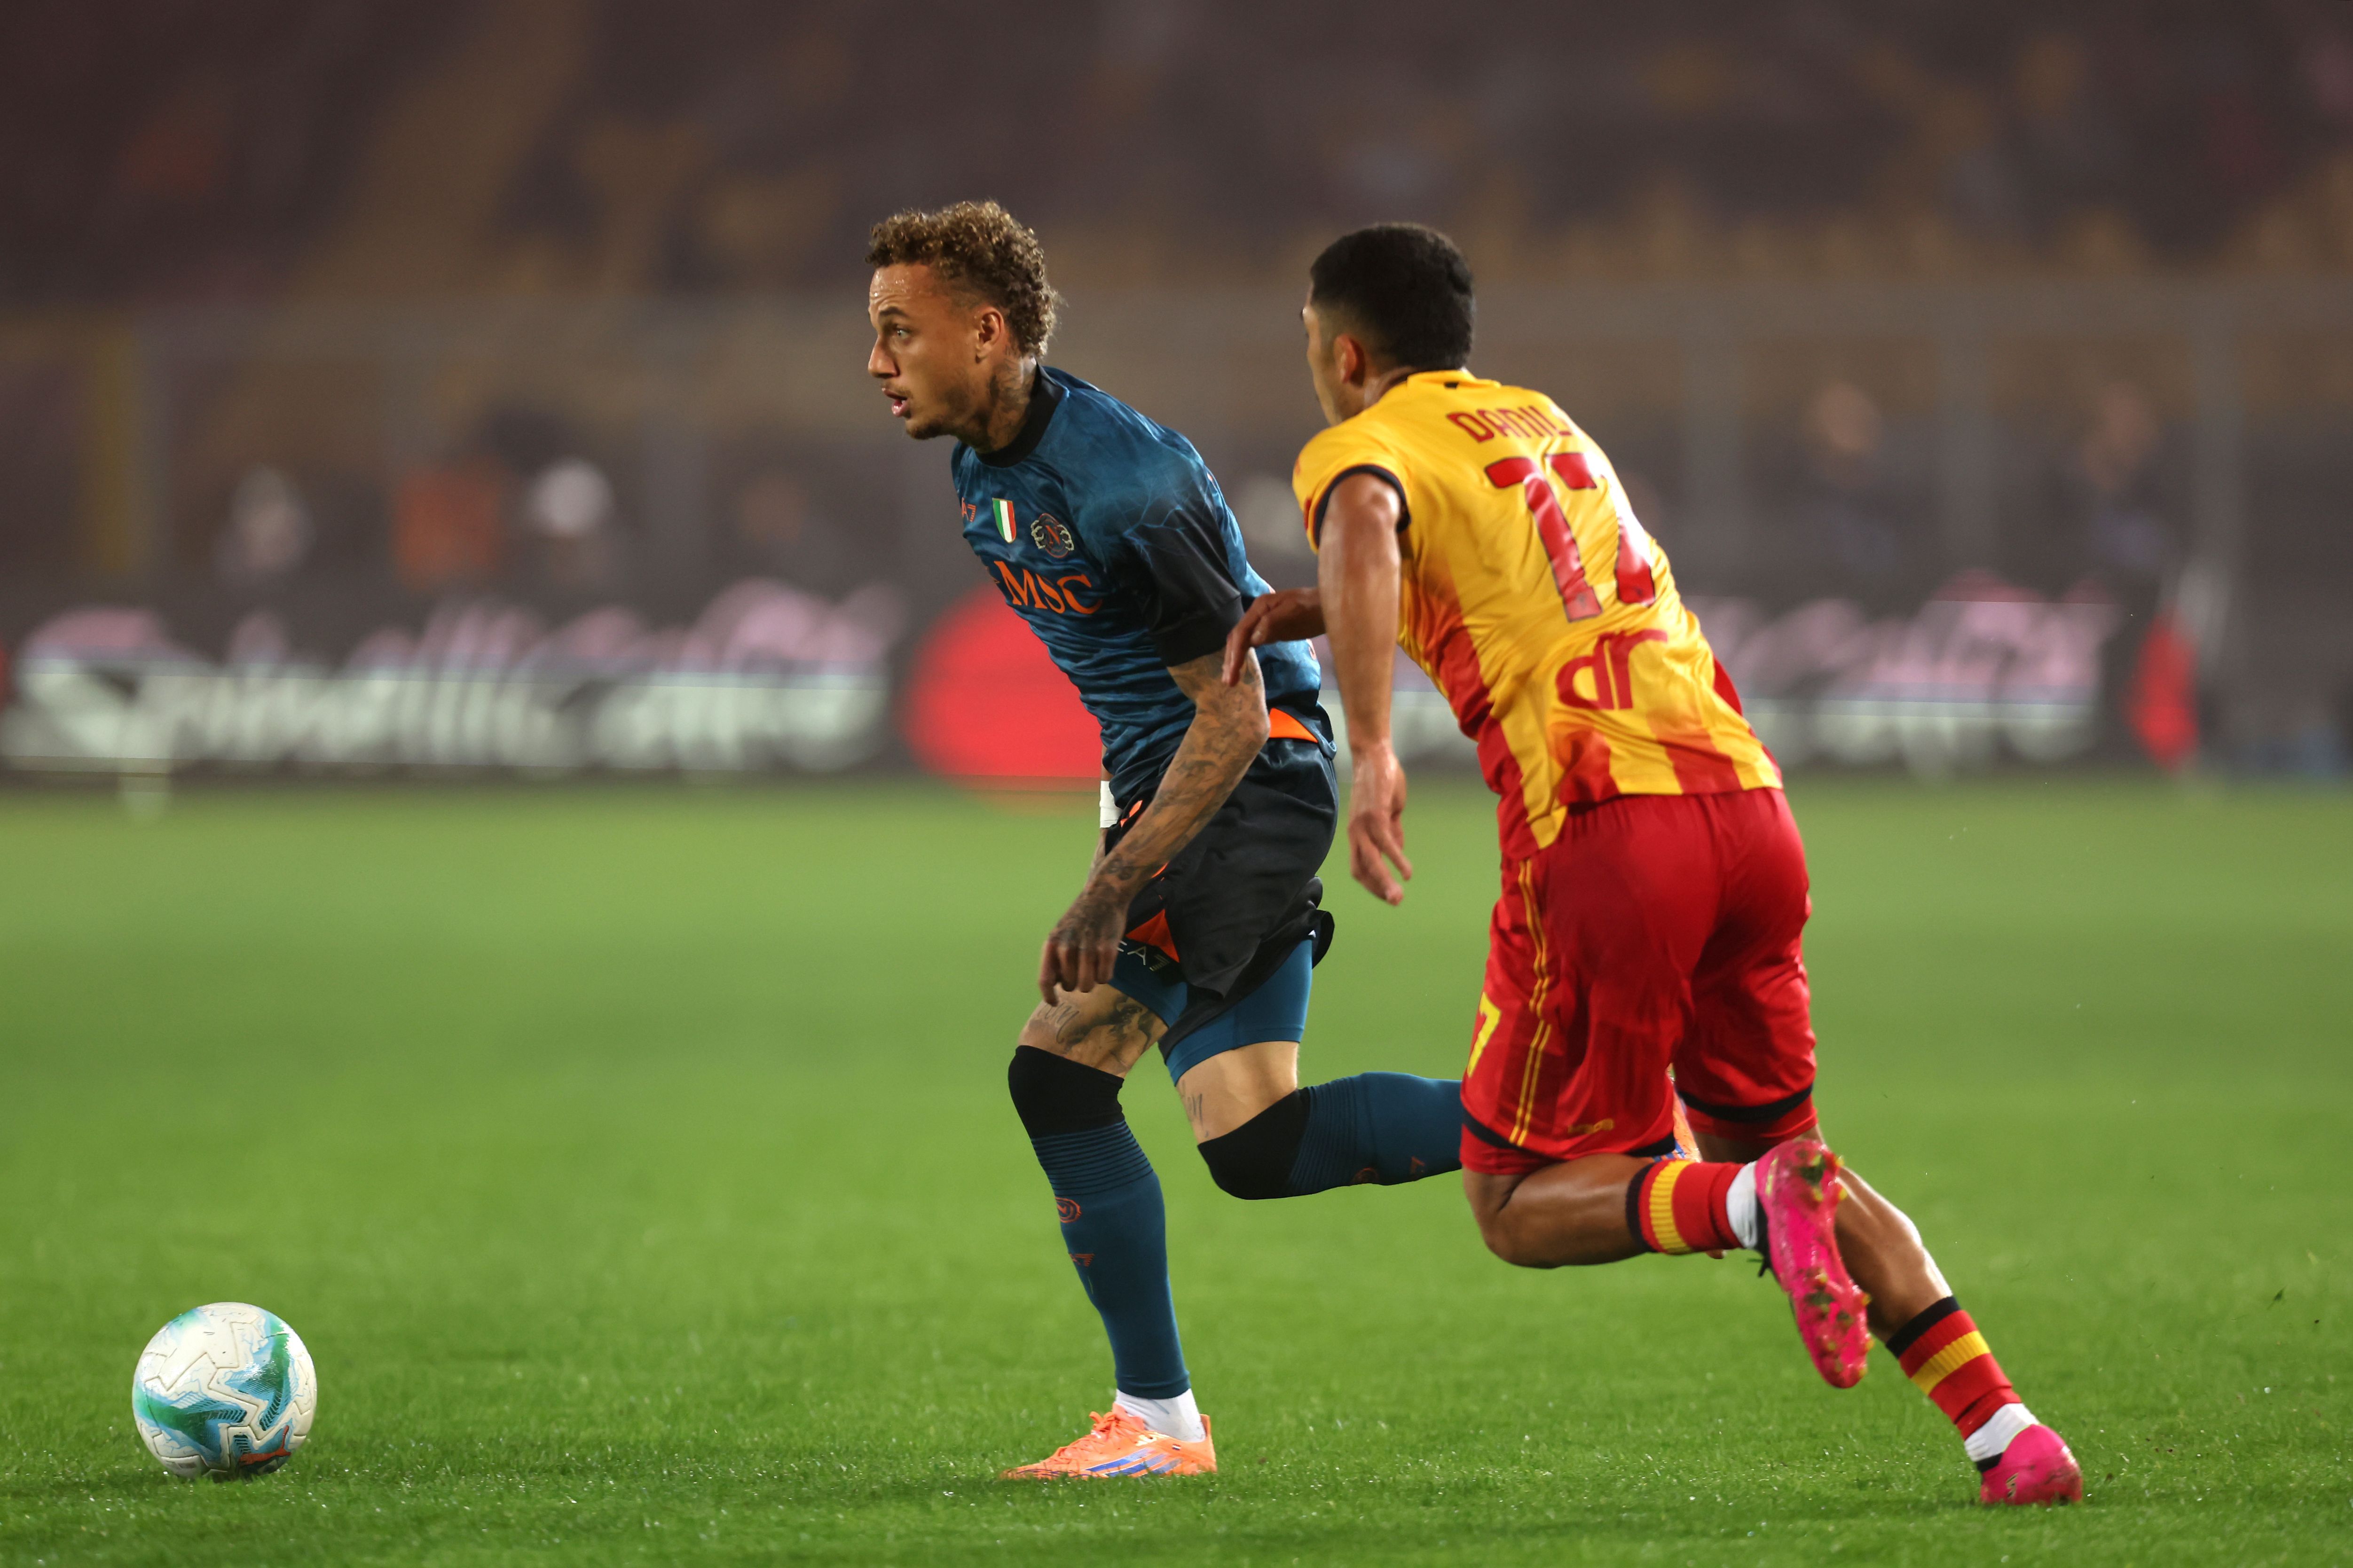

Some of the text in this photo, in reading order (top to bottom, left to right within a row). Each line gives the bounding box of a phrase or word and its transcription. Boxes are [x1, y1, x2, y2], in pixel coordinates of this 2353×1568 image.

[1445, 405, 1572, 443] DANIL
[961, 497, 976, 523] A7
[1484, 452, 1656, 623] 77
[993, 560, 1102, 614] MSC
[1555, 627, 1668, 712] dr
[1466, 991, 1502, 1079] 7
